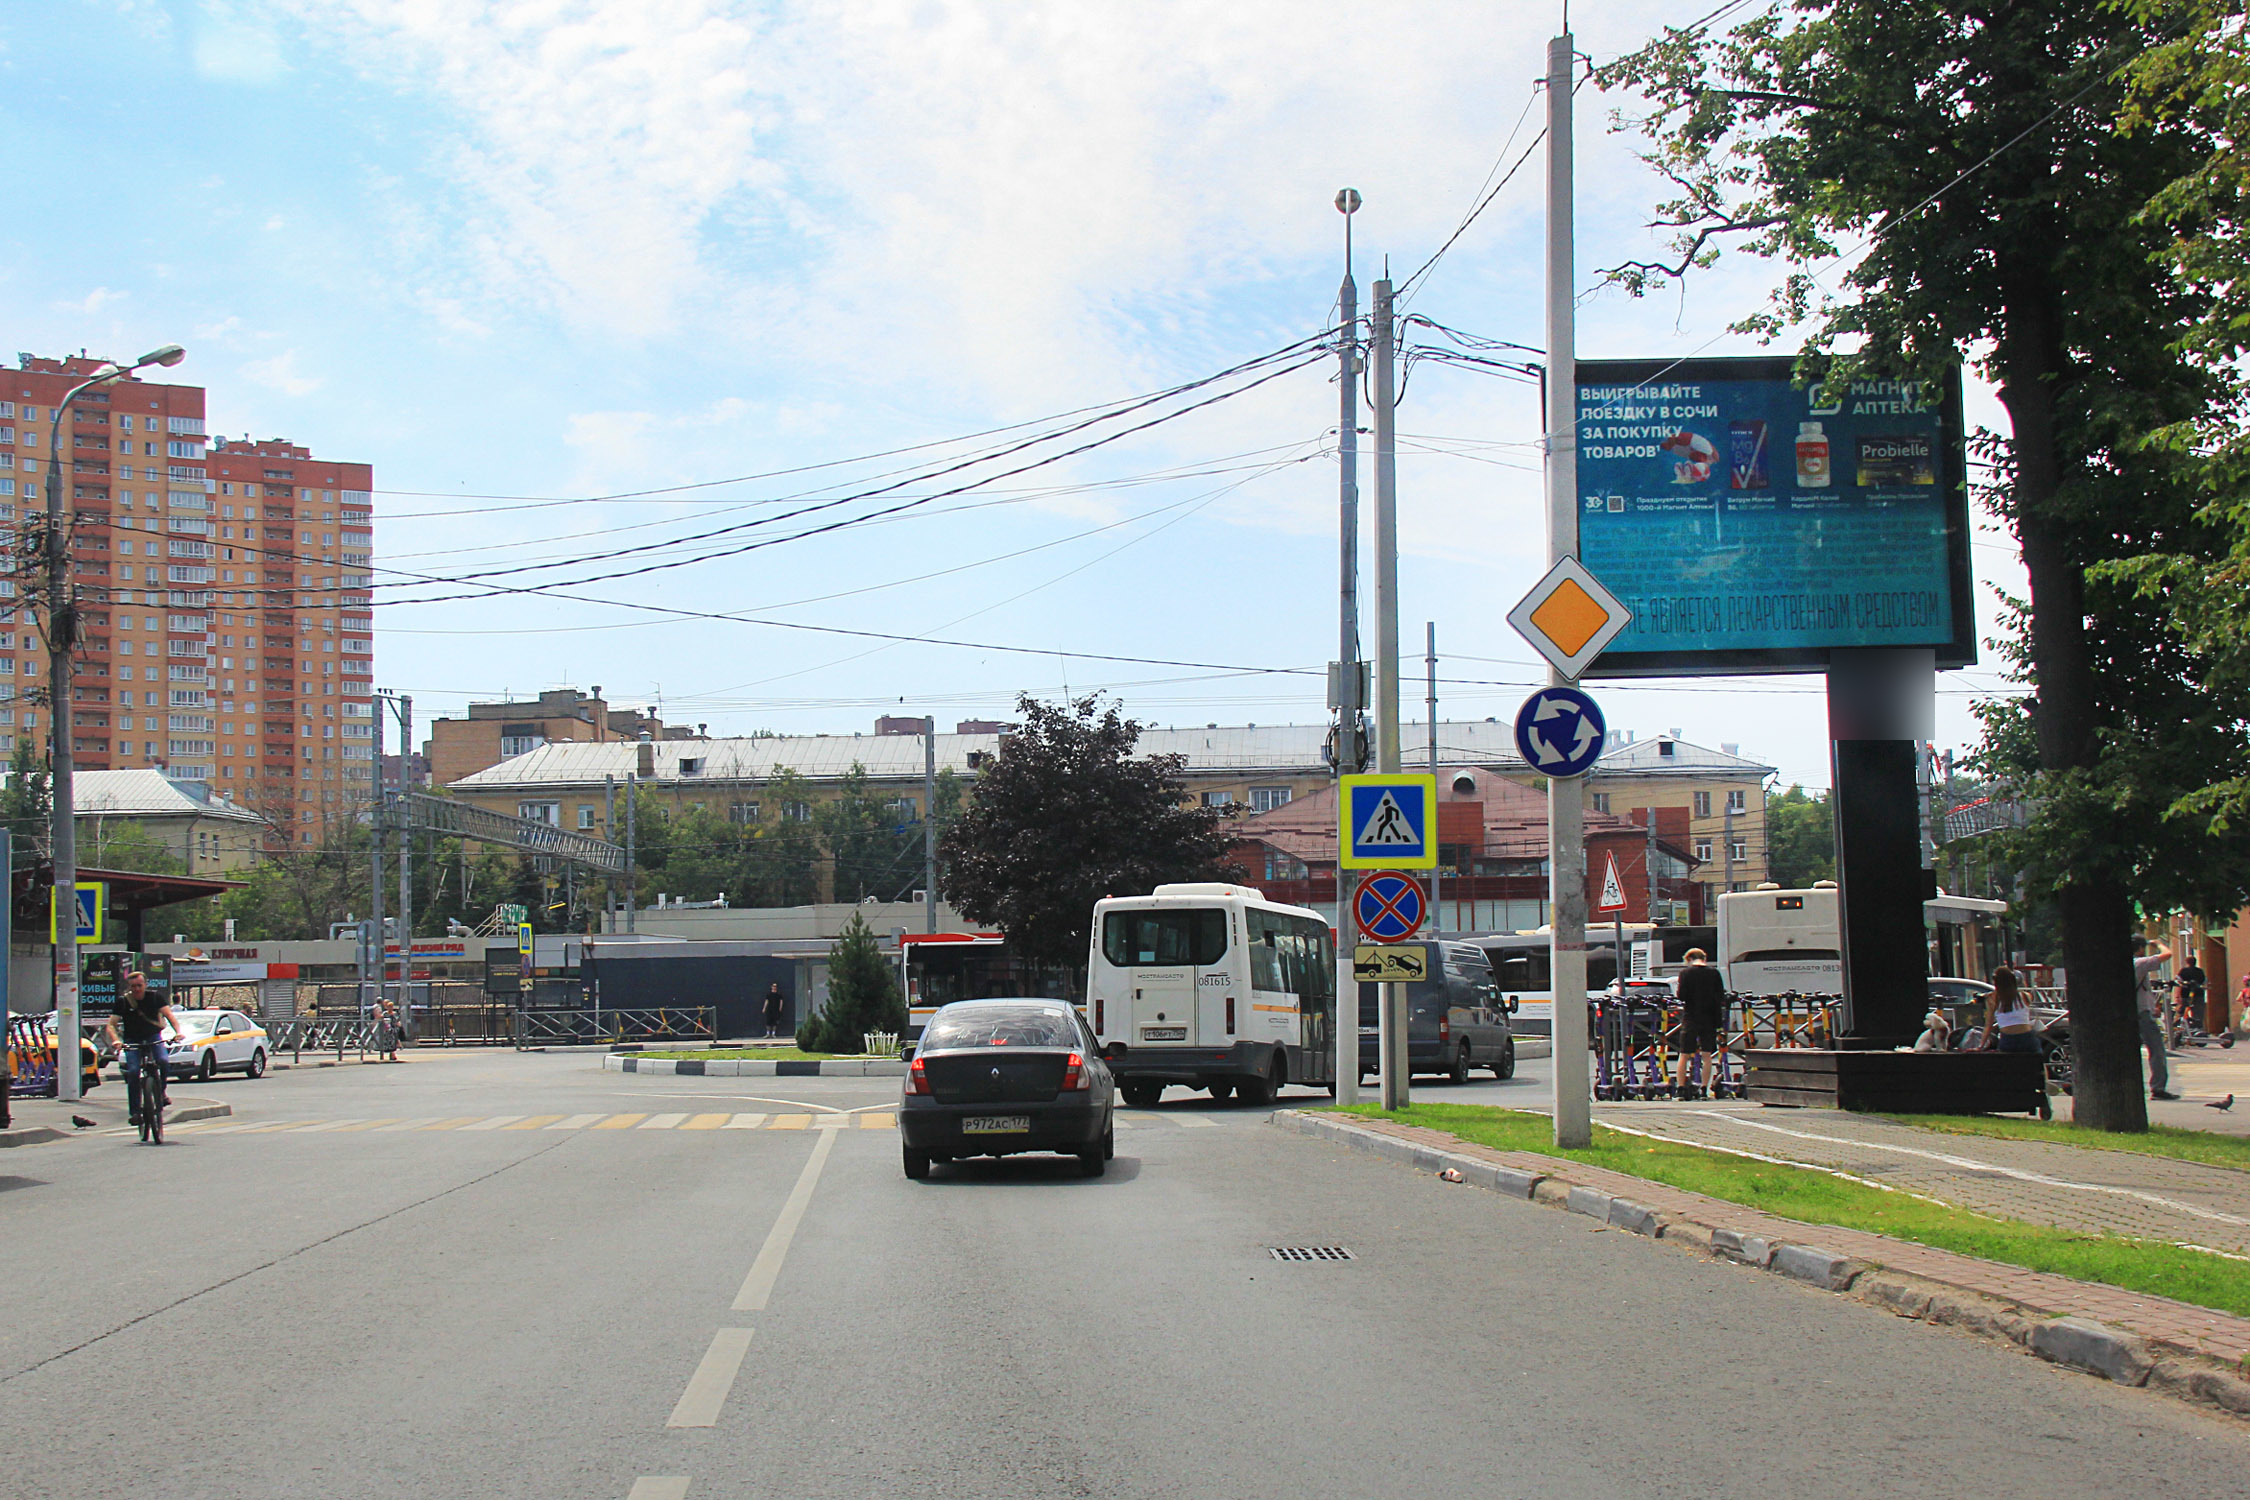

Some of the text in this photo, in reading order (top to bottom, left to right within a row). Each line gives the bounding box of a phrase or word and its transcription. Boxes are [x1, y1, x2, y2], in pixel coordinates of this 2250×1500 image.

[1580, 383, 1701, 401] ВЫИГРЫВАЙТЕ
[1850, 380, 1924, 396] МАГНИТ
[1581, 405, 1718, 421] ПОЕЗДКУ В СОЧИ
[1852, 400, 1928, 415] АПТЕКА
[1582, 425, 1682, 440] ЗА ПОКУПКУ
[1862, 444, 1929, 457] Probielle
[1626, 591, 1939, 634] НЕ ЯВЛЯЕТСЯ ЛЕКАРСТВЕННЫМ СРЕДСТВОМ
[211, 948, 258, 959] БУЛОЧНАЯ
[1198, 977, 1231, 986] 081615
[965, 1117, 1028, 1130] Р972АС 177
